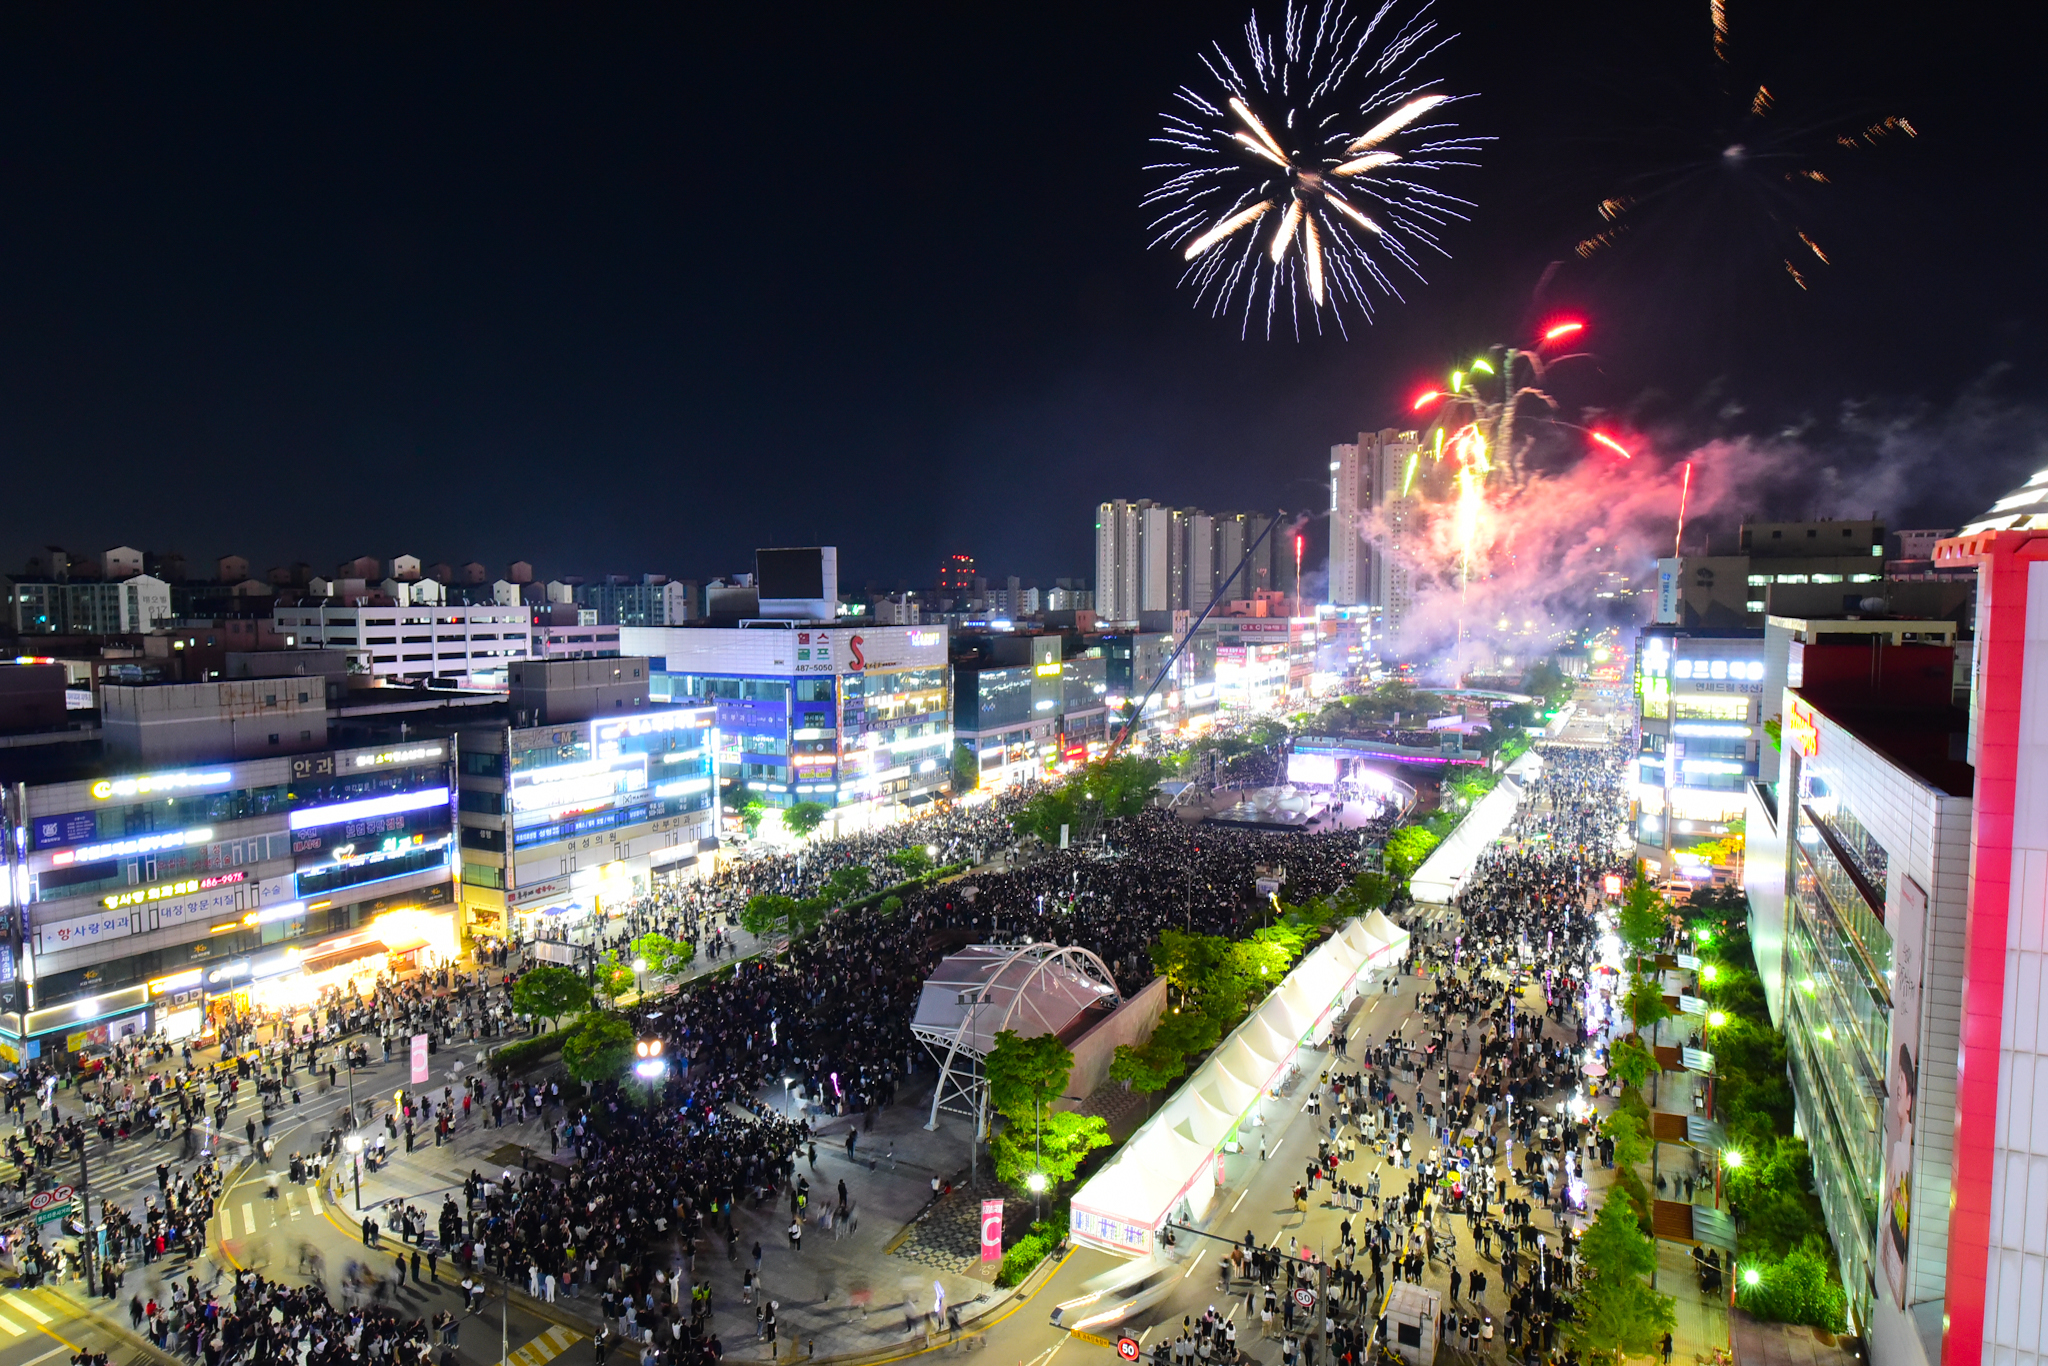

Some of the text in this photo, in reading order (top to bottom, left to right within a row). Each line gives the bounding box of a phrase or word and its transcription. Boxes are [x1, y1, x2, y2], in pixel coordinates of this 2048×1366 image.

[148, 606, 167, 614] 617
[849, 635, 865, 671] S
[795, 664, 833, 672] 487-5050
[1695, 682, 1735, 693] 연세드림
[293, 756, 334, 779] 안과
[652, 815, 691, 832] 산부인과
[568, 832, 617, 850] 여성의원
[160, 884, 281, 918] 대장 항문 치질 수술
[34, 1196, 48, 1206] 50
[982, 1216, 1001, 1247] C
[1298, 1292, 1310, 1303] 50
[1122, 1343, 1135, 1356] 50
